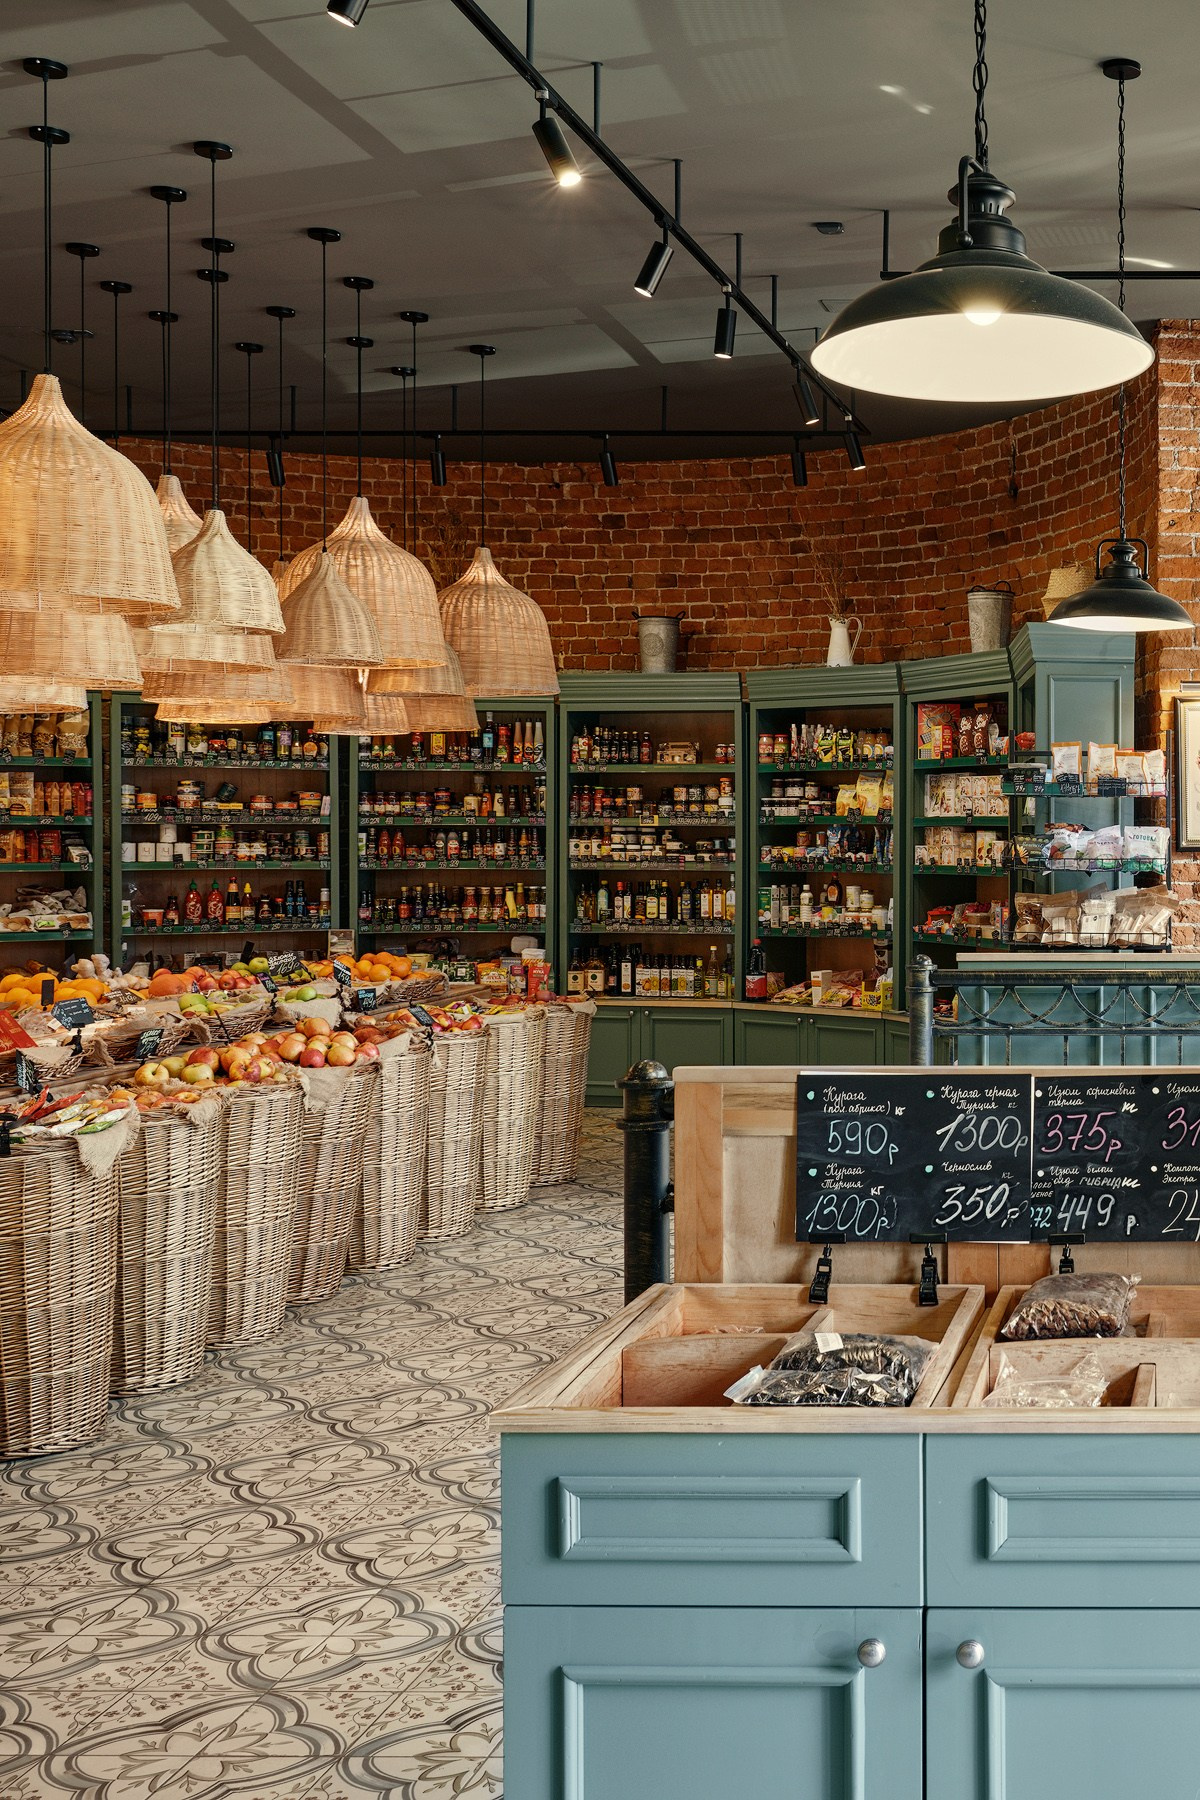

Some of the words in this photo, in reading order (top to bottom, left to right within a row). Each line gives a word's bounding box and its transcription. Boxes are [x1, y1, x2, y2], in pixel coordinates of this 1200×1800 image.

[823, 1086, 867, 1106] Курага
[940, 1086, 981, 1105] Курага
[984, 1085, 1020, 1102] черная
[1047, 1085, 1082, 1102] Изюм
[1166, 1082, 1200, 1099] Изюм
[956, 1100, 998, 1114] Турция
[824, 1163, 866, 1180] Курага
[941, 1160, 993, 1173] Чернослив
[1050, 1166, 1080, 1179] Изюм
[821, 1179, 864, 1190] Турция
[1079, 1176, 1121, 1189] ГИБРИД
[1162, 1174, 1198, 1184] Экстра
